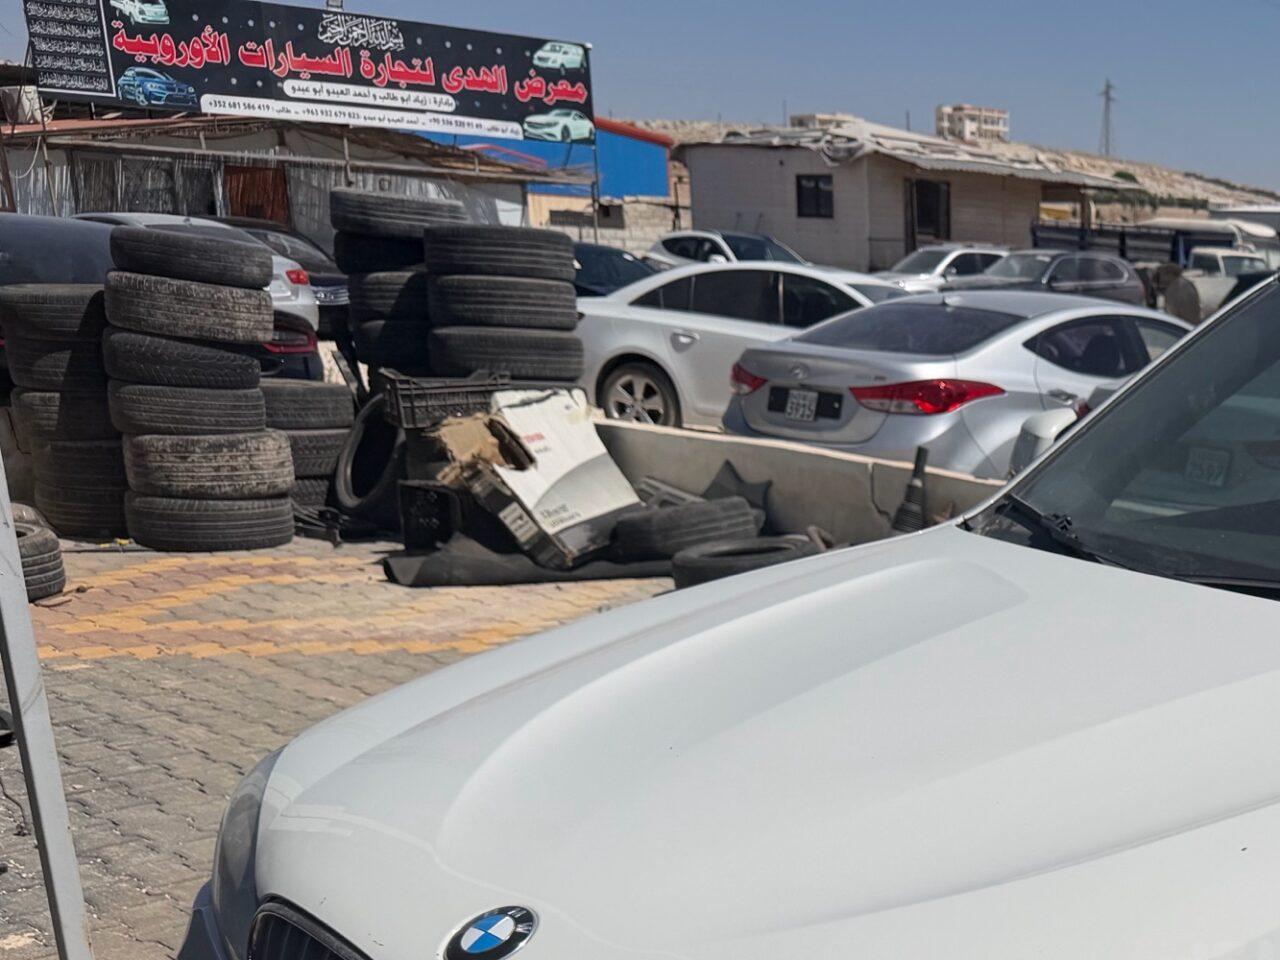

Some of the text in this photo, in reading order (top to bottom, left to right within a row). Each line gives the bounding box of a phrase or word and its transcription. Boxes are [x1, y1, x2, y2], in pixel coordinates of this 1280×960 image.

[111, 20, 231, 69] الأوروبية
[238, 38, 353, 80] السيارات
[360, 50, 436, 88] لتجارة
[441, 65, 508, 95] الهدى
[514, 68, 588, 103] معرض
